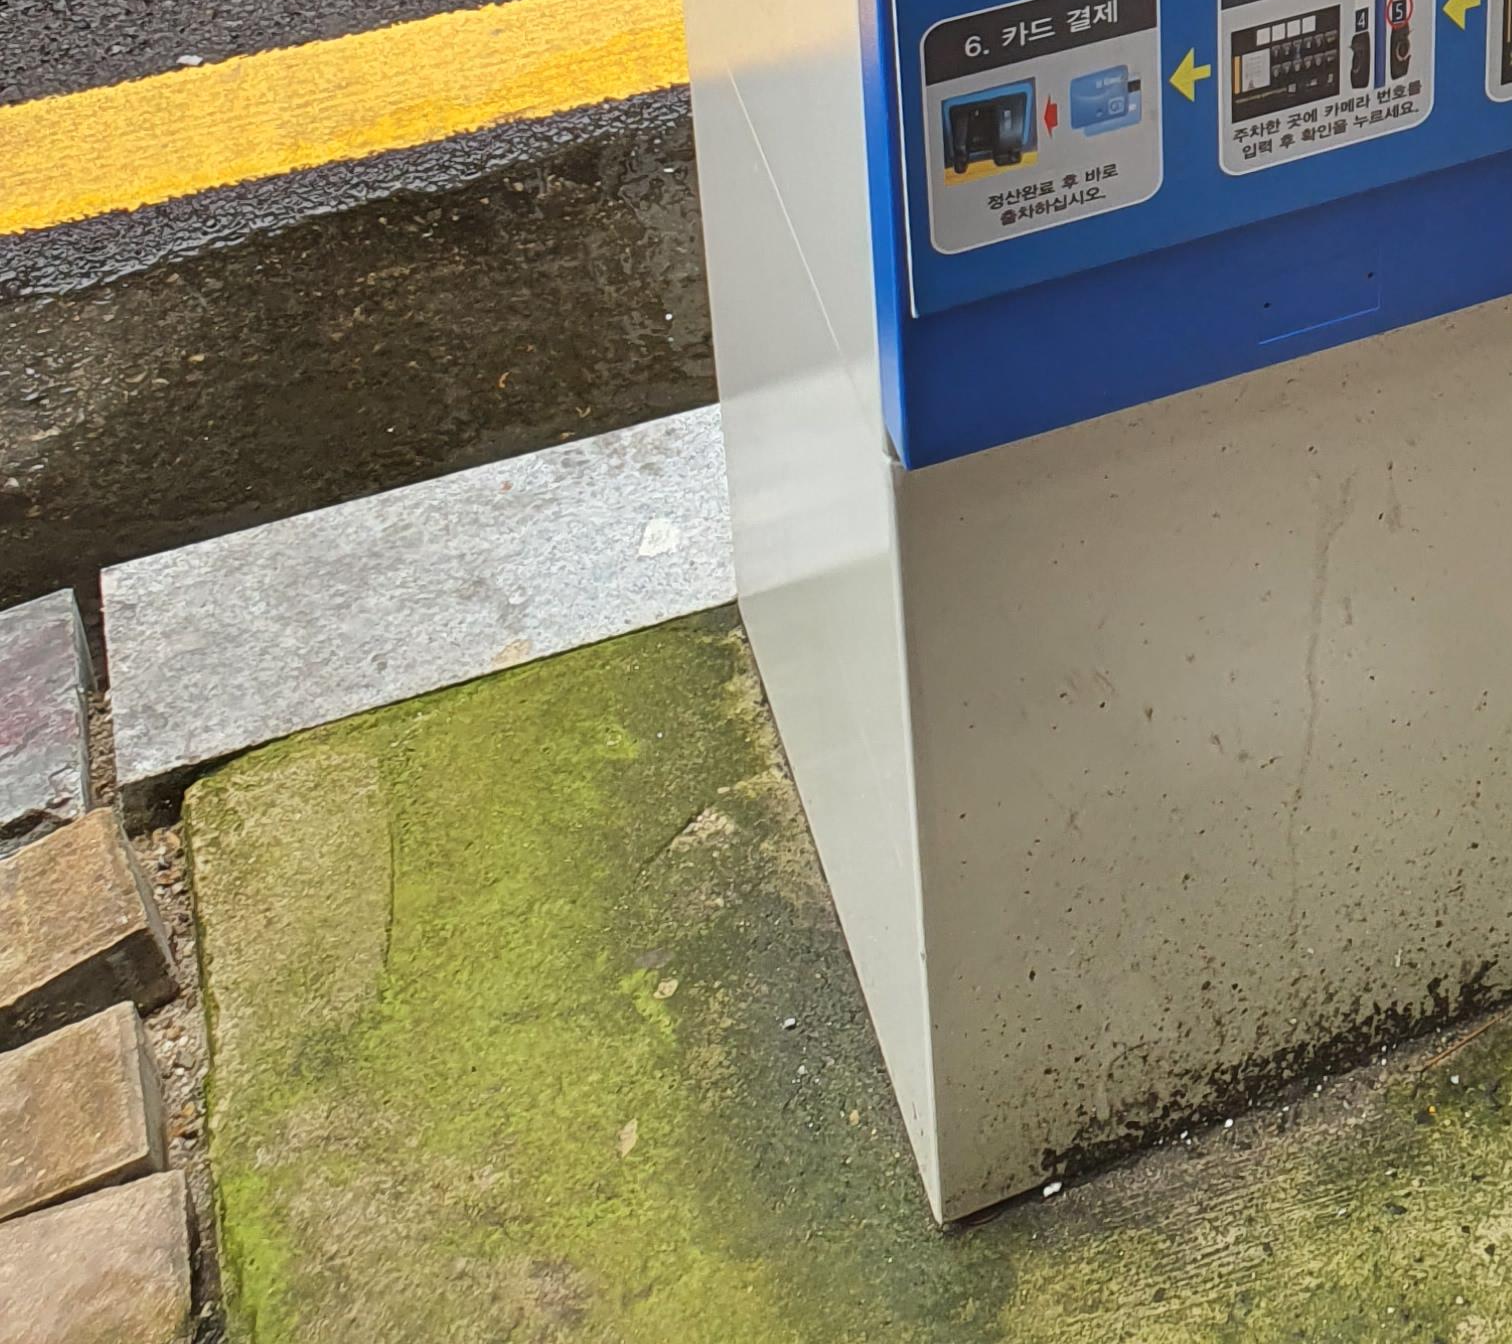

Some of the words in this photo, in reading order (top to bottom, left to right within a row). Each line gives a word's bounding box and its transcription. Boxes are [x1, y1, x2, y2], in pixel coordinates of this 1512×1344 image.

[964, 35, 990, 57] 6.
[1001, 16, 1055, 47] 카드
[1233, 118, 1281, 143] 주차한
[1288, 107, 1318, 129] 곳에
[1324, 93, 1370, 119] 카메라
[1376, 80, 1422, 104] 번호를
[1242, 138, 1273, 160] 입력
[1280, 133, 1296, 149] 후
[1301, 119, 1349, 143] 확인을
[1352, 101, 1420, 129] 누르세요.
[987, 180, 1055, 210] 정산완료
[1061, 174, 1080, 190] 후
[1085, 163, 1119, 182] 바로
[1000, 187, 1106, 226] 출차하십시오.
